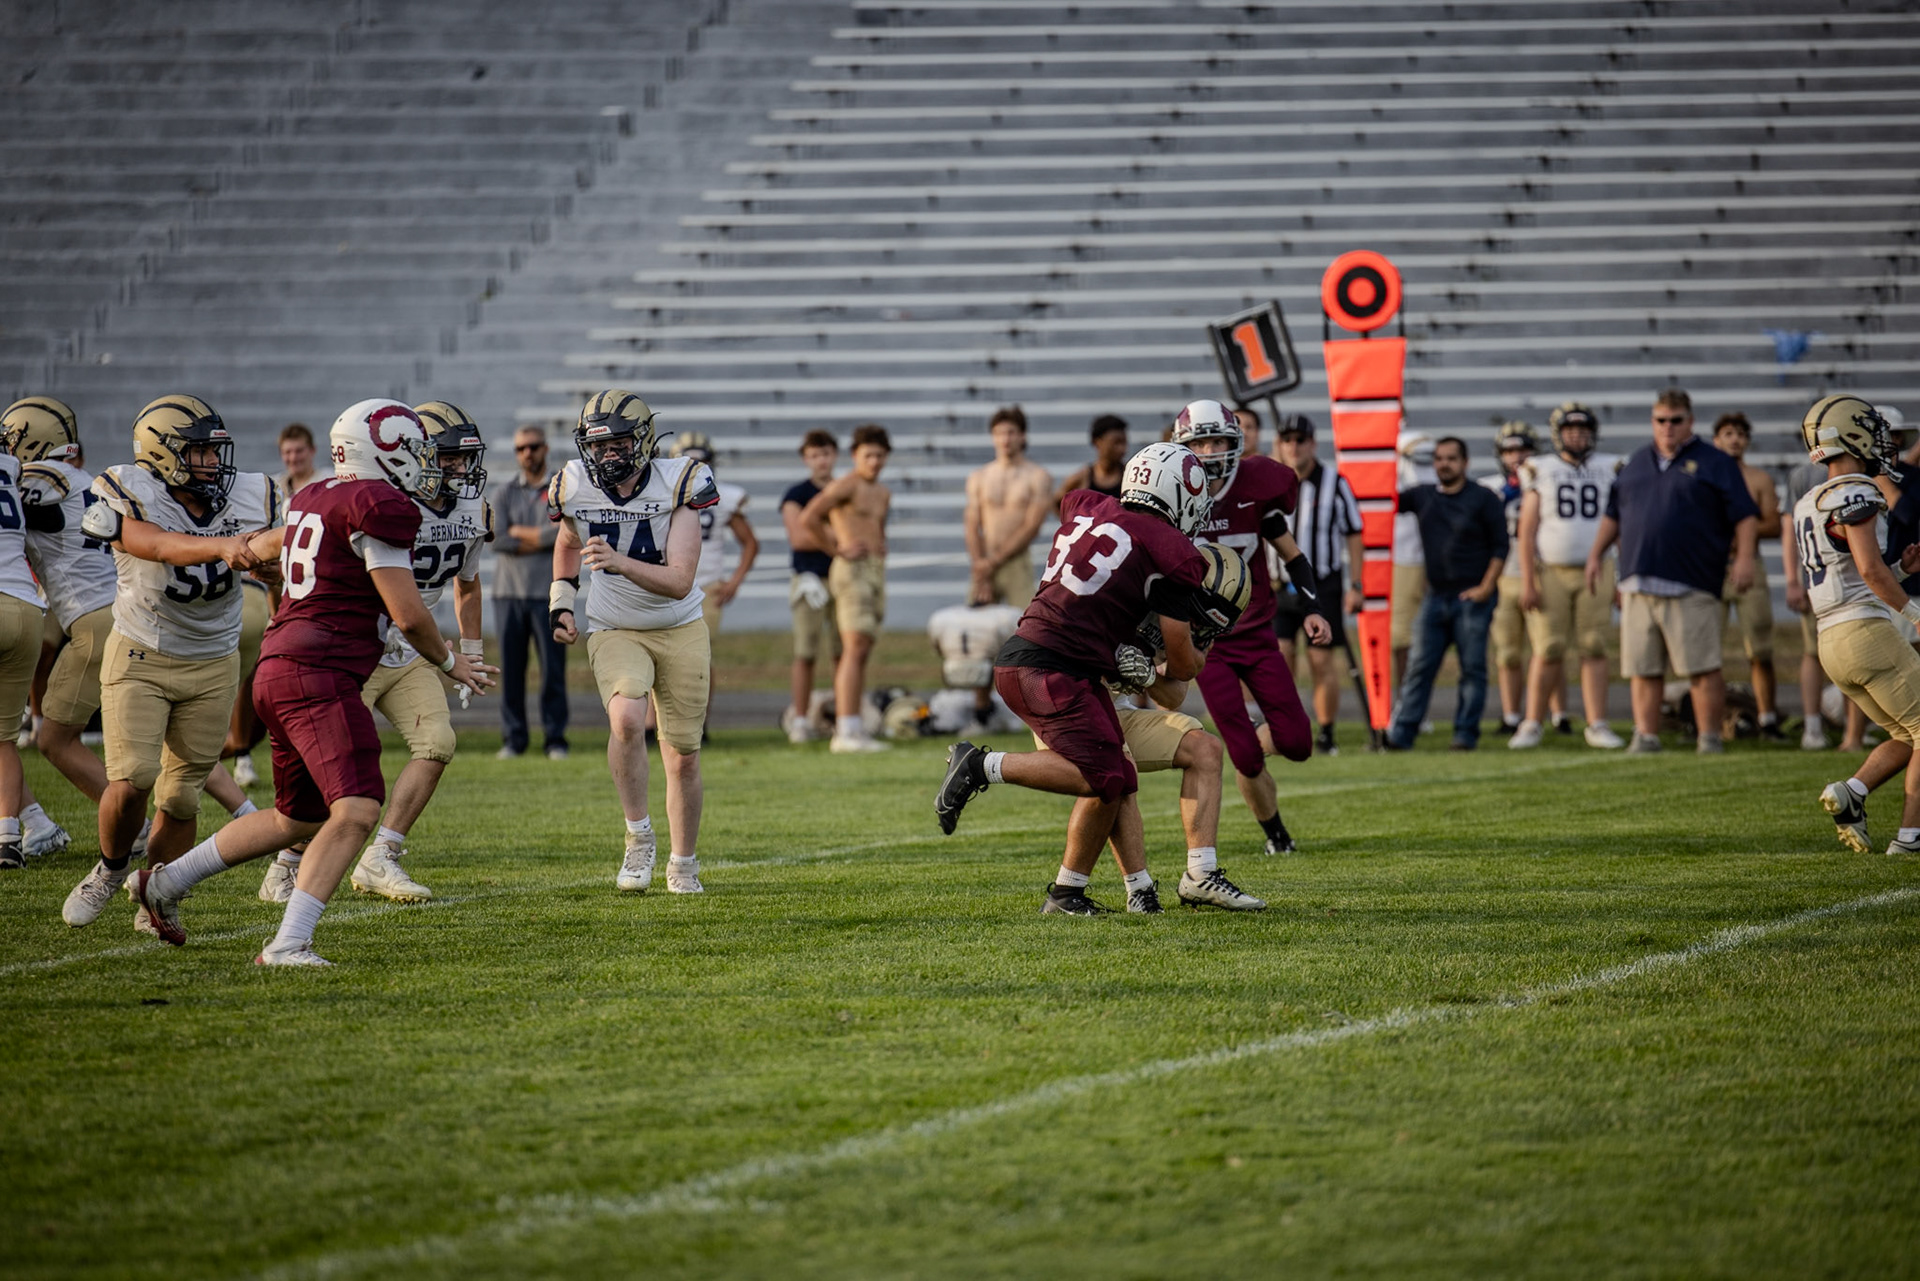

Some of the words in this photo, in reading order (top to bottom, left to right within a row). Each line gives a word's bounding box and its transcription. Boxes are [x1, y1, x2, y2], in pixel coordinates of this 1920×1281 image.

[1233, 321, 1276, 385] 1
[1130, 466, 1151, 485] 33
[1558, 484, 1598, 519] 68
[280, 510, 325, 600] 58
[413, 542, 466, 591] 22
[589, 519, 667, 575] 74
[1041, 516, 1132, 596] 33
